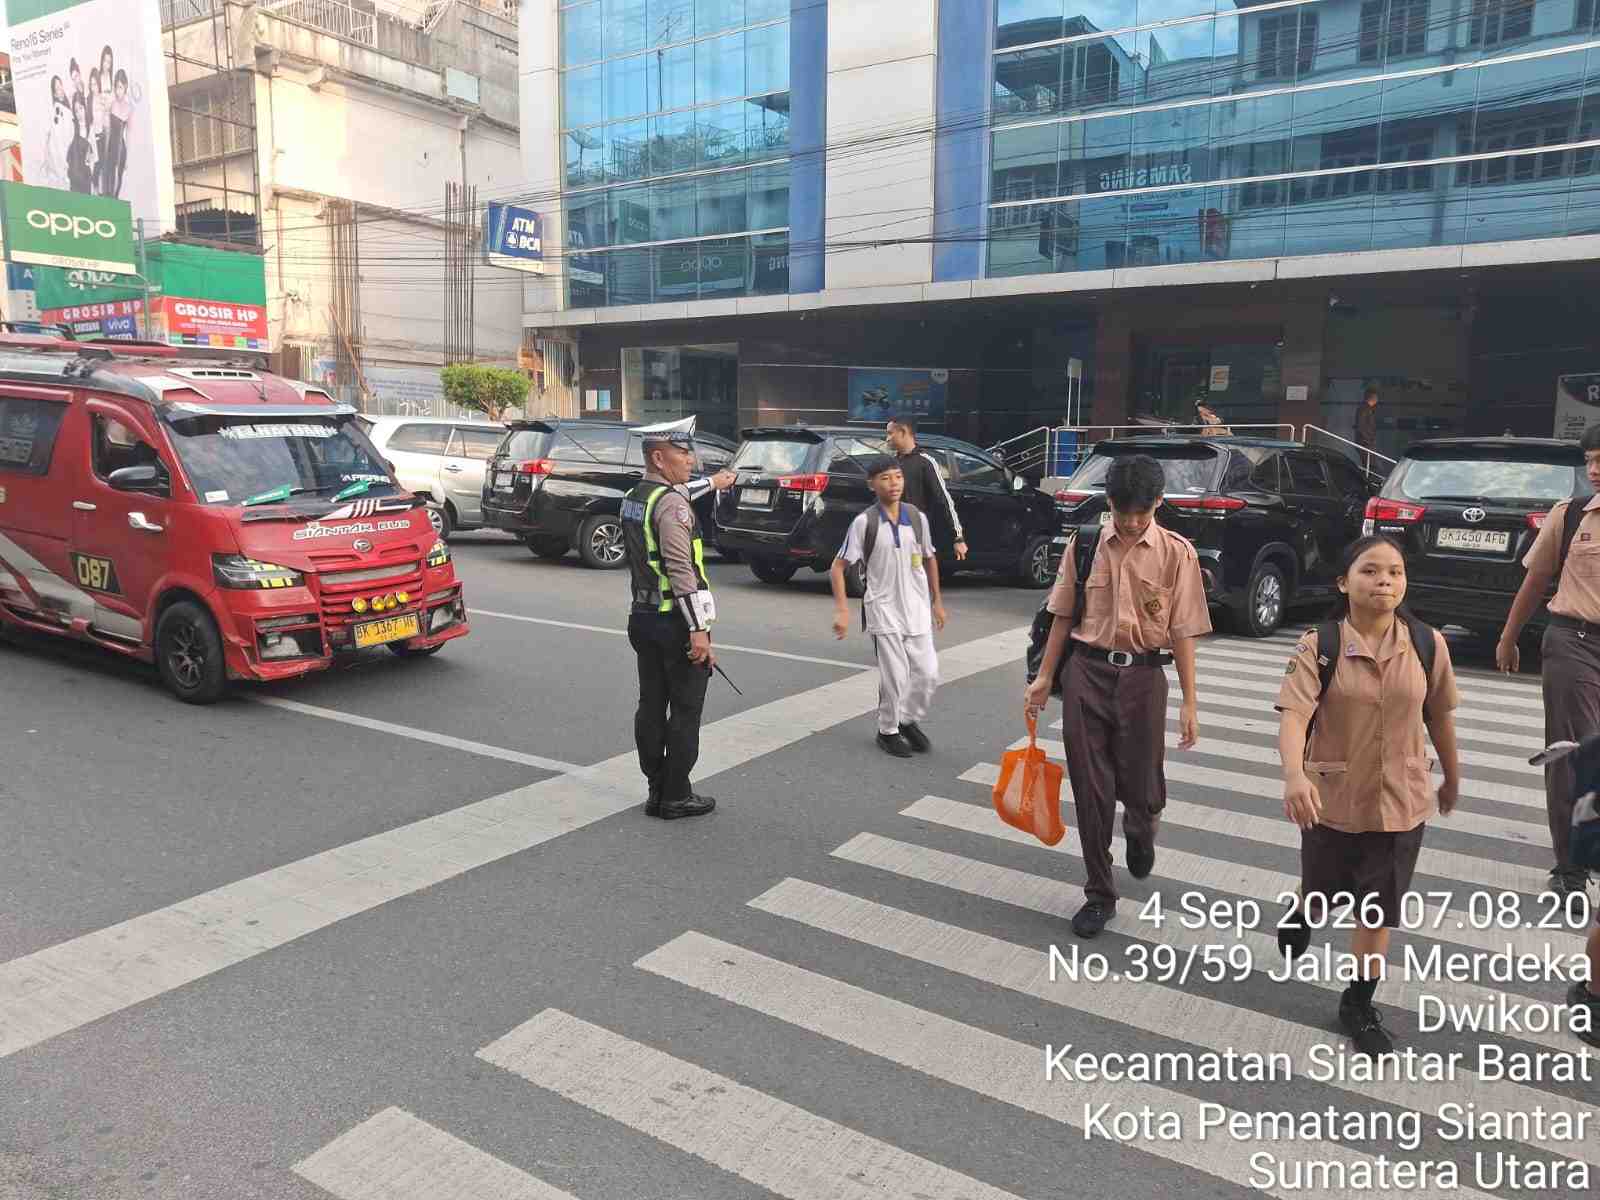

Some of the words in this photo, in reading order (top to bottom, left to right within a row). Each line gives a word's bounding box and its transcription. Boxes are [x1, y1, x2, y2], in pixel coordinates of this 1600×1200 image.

[39, 27, 64, 44] Series
[27, 208, 117, 239] oppo
[512, 217, 535, 234] ATM
[518, 235, 541, 252] BCA
[63, 303, 116, 320] GROSIR
[122, 300, 141, 314] HP
[174, 302, 233, 320] GROSIR
[237, 309, 258, 321] HP
[292, 523, 375, 540] SIANTAR
[377, 518, 411, 531] BUS
